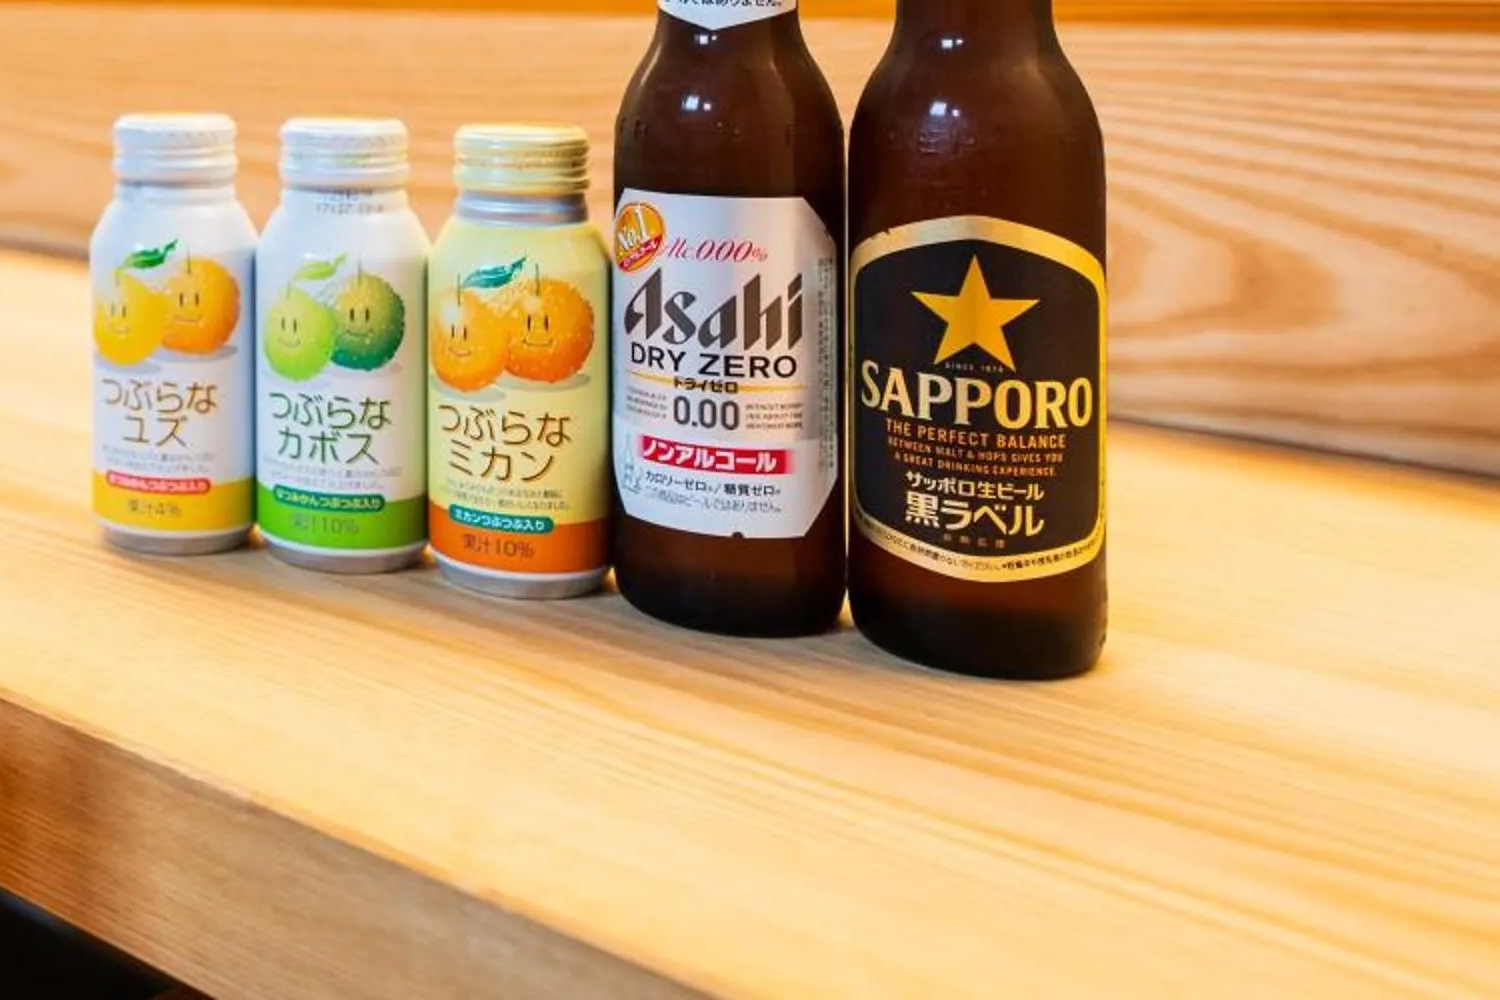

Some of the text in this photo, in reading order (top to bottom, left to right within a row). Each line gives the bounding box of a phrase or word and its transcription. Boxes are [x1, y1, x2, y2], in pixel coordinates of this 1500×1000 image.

[624, 268, 802, 350] Asahi
[631, 342, 797, 378] DRY ZERO
[102, 378, 218, 414] つぶらな
[673, 378, 740, 394] ドライゼロ
[861, 359, 1093, 430] SAPPORO
[269, 392, 392, 430] つぶらな
[438, 404, 572, 447] つぶらな
[673, 396, 740, 430] 0.00
[122, 415, 188, 446] ユズ
[278, 427, 379, 464] カボス
[886, 418, 1067, 449] THE PERFECT BALANCE
[449, 439, 554, 481] ミカン
[644, 440, 777, 472] ノンアルコール
[888, 436, 931, 453] BETWEEN
[936, 444, 963, 459] MALT
[978, 452, 1007, 462] HOPS
[1011, 452, 1041, 463] GIVES
[903, 453, 933, 468] GREAT
[937, 459, 989, 475] DRINKING
[905, 470, 1045, 501] サッポロ生ビール
[455, 508, 545, 531] ミカンつぶつぶ入り
[905, 491, 1045, 537] 黒ラベル
[463, 534, 535, 558] 果汁10%
